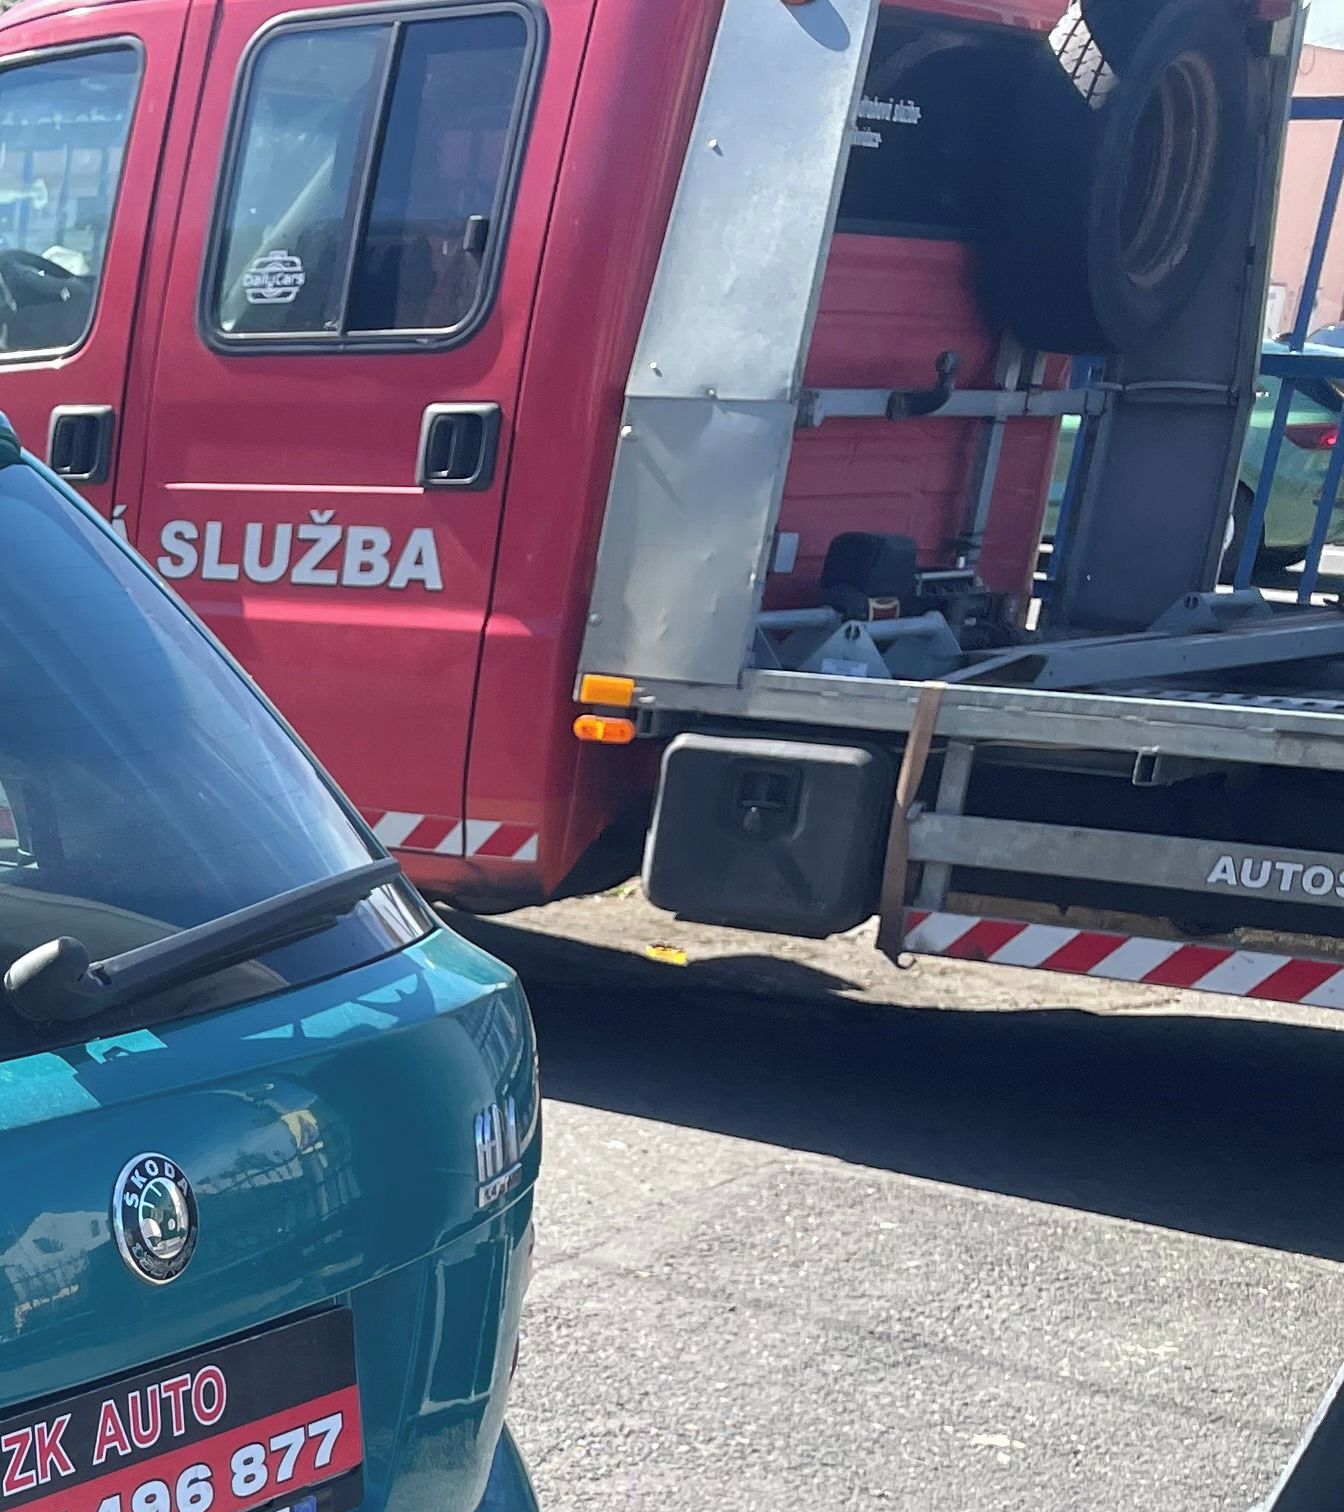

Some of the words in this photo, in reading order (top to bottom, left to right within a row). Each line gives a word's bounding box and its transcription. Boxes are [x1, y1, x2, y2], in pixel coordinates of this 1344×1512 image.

[156, 509, 444, 591] SLUŽBA
[124, 1159, 189, 1208] ŠKODA
[1, 1414, 75, 1496] ZK
[92, 1365, 227, 1464] AUTO
[230, 1413, 344, 1498] 877
